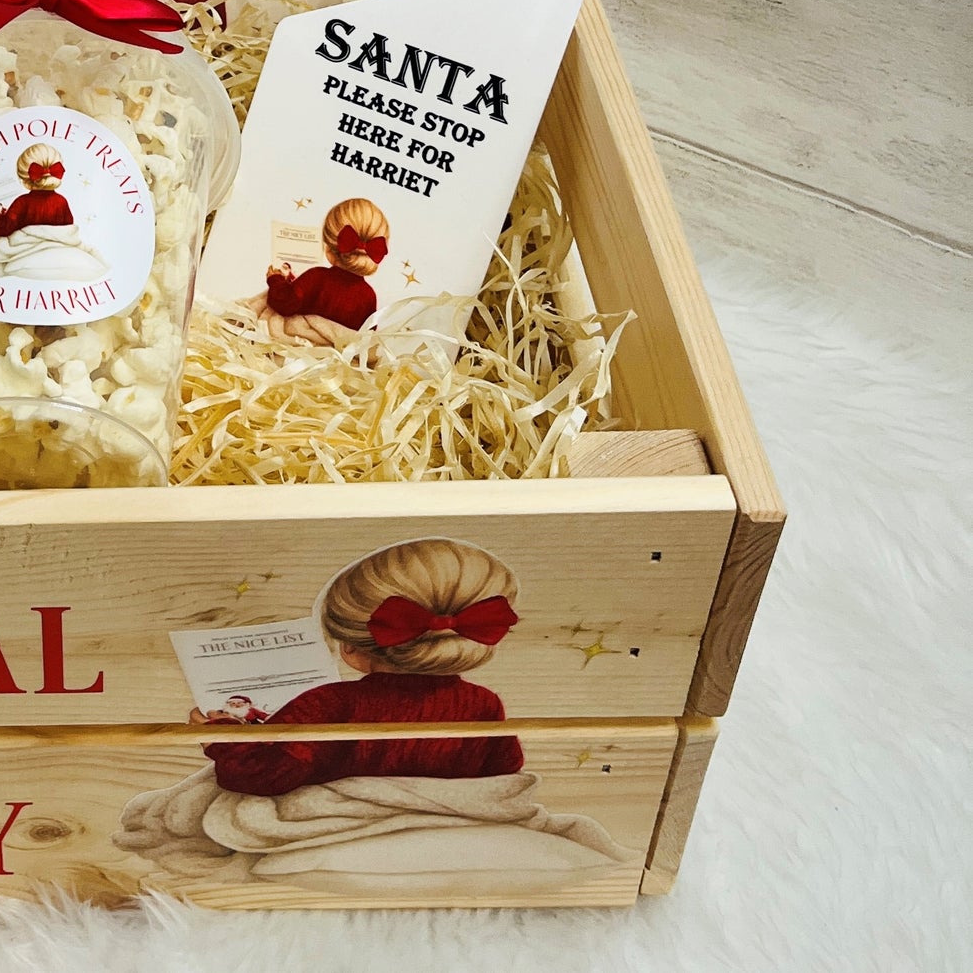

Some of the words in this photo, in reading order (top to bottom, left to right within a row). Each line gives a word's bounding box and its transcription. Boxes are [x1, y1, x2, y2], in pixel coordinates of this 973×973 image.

[315, 19, 509, 126] SANTA
[323, 75, 418, 126] PLEASE
[420, 112, 485, 148] STOP
[13, 119, 80, 142] POLE
[85, 131, 144, 215] TREATS
[330, 142, 439, 197] HARRIET
[337, 113, 403, 153] HERE
[406, 138, 455, 173] FOR
[15, 279, 116, 315] HARRIET
[199, 643, 229, 653] THE
[235, 639, 269, 649] NICE
[273, 632, 306, 644] LIST
